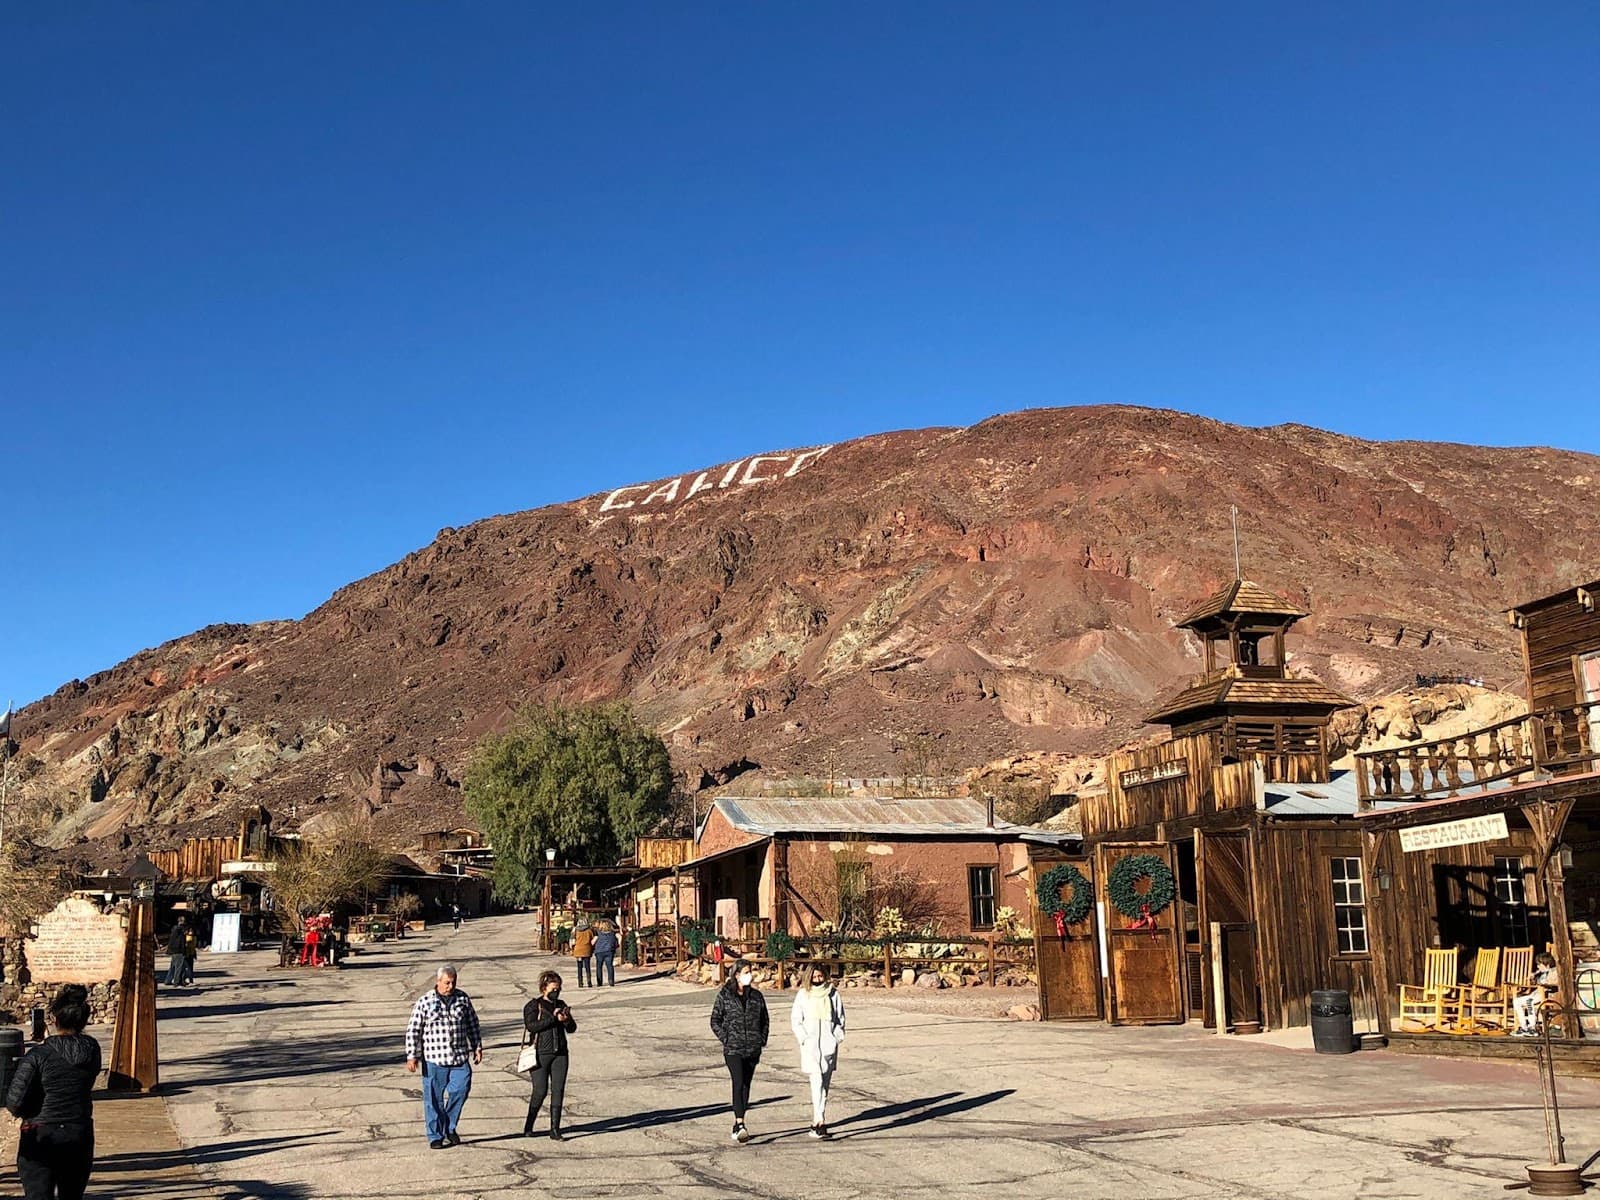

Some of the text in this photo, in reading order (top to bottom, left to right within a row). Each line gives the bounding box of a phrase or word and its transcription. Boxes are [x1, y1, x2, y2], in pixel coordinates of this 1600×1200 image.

[1122, 761, 1181, 786] FIRE HALL
[1402, 817, 1502, 848] RESTAURANT
